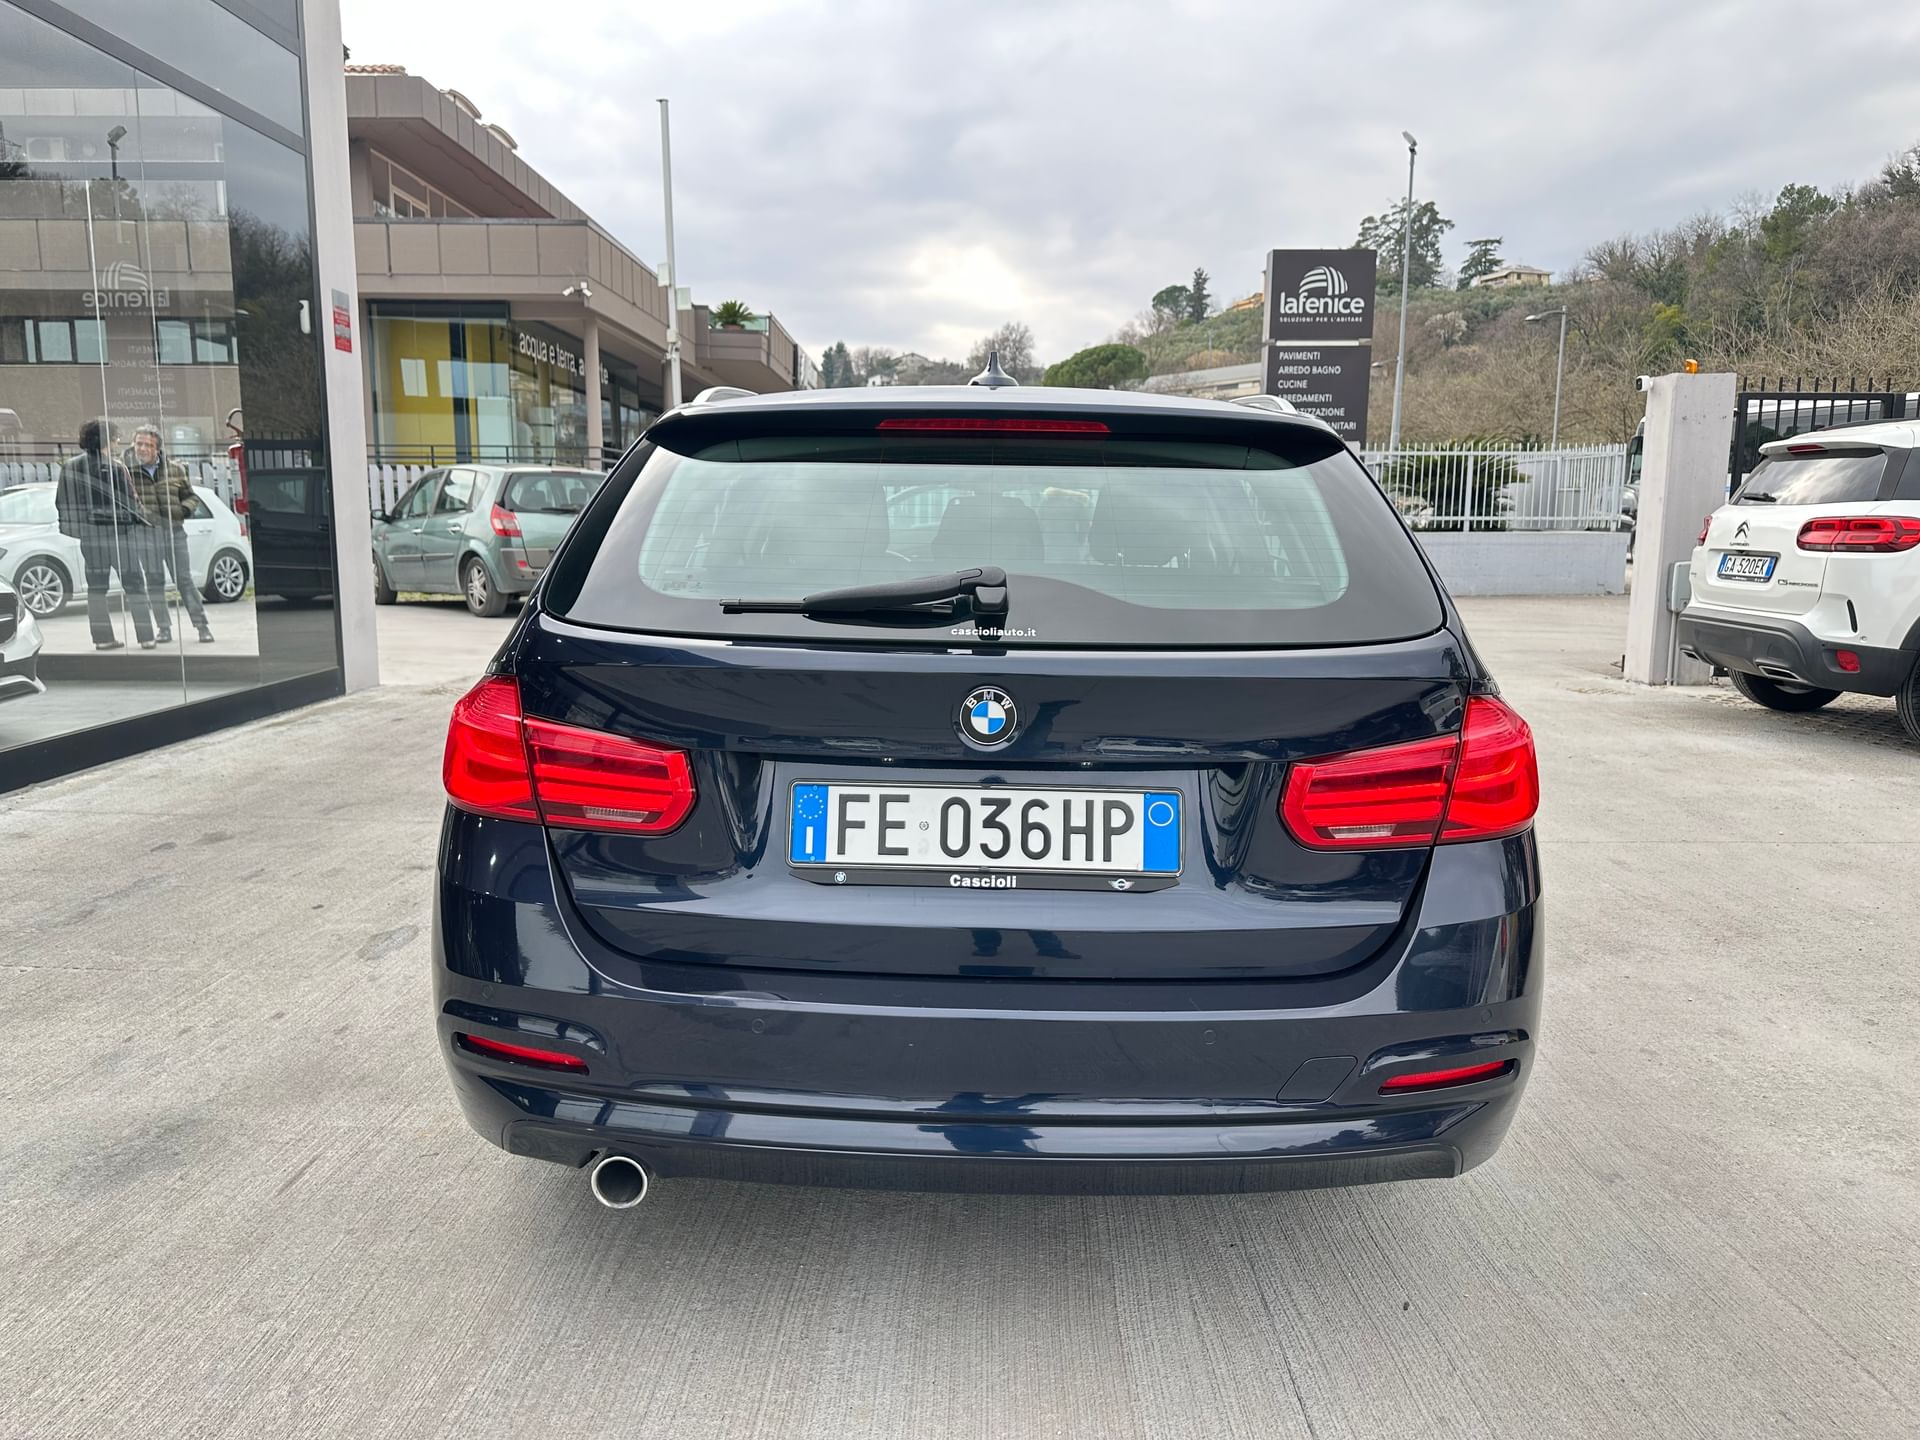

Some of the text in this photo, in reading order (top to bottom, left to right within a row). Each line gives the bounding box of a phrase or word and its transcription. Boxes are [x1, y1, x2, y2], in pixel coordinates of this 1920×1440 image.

[1280, 292, 1365, 314] lafenice
[520, 332, 548, 365] acqua
[549, 345, 555, 364] e
[557, 343, 577, 377] terra,
[1280, 352, 1321, 360] PAVIMENTI
[1278, 366, 1341, 375] ARREDO BAGNO
[1278, 380, 1308, 389] CUCINE
[1724, 557, 1768, 576] GA 520EK
[951, 626, 1037, 637] cascioliauto.it
[966, 690, 1013, 710] BMW
[836, 793, 911, 856] FE
[940, 796, 1135, 863] 036HP
[949, 874, 1017, 889] Cascioli
